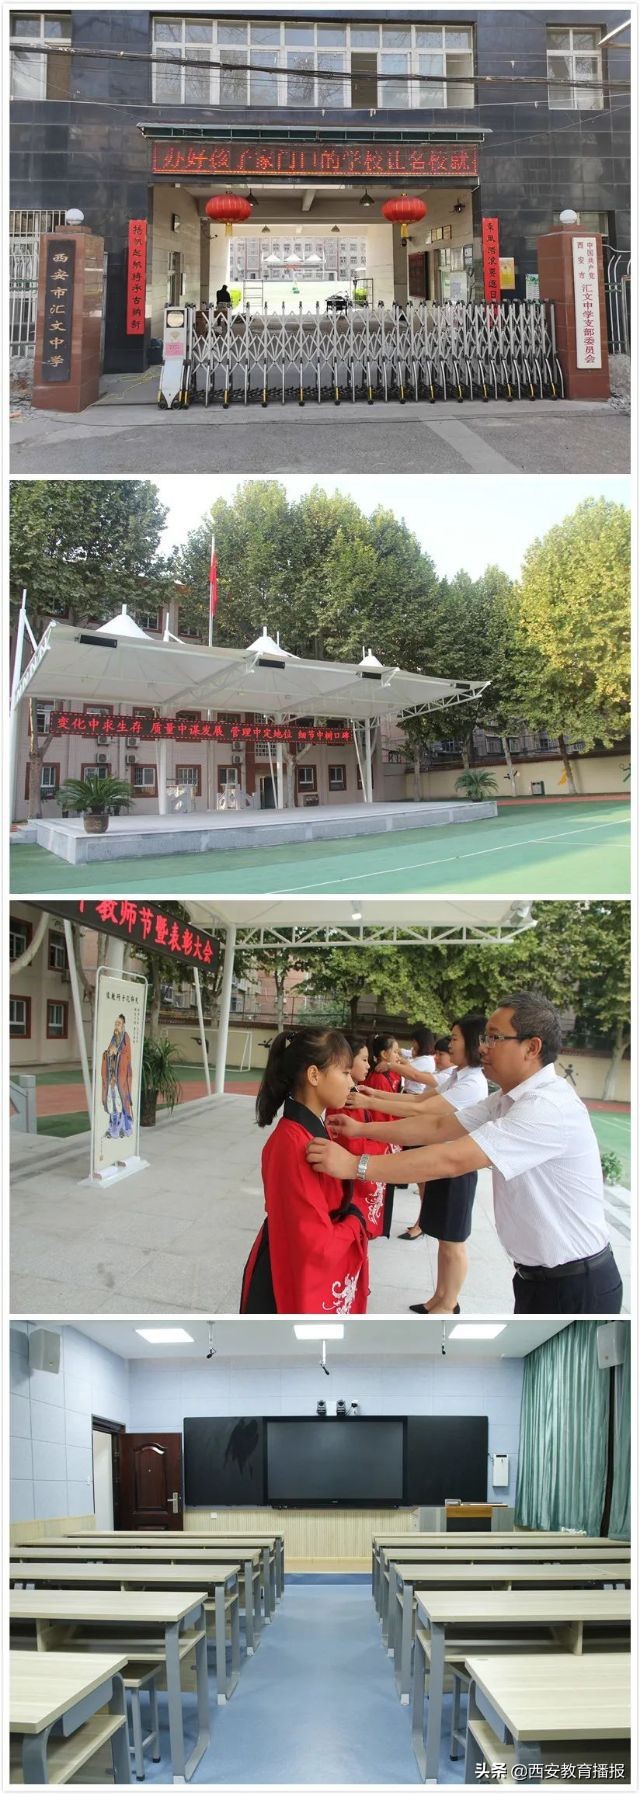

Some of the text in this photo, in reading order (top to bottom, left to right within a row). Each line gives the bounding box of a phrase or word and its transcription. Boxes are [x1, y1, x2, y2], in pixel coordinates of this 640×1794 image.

[577, 241, 585, 280] 西安市
[586, 242, 596, 280] 中国共产党
[49, 253, 69, 368] 西安市汇文中学
[582, 284, 596, 364] 汇文中学支部委员会
[57, 716, 350, 742] 变化中求生存 质量中谋发展 管理中定地位 细节中树口碑
[79, 900, 213, 965] 教师节暨表彰大会
